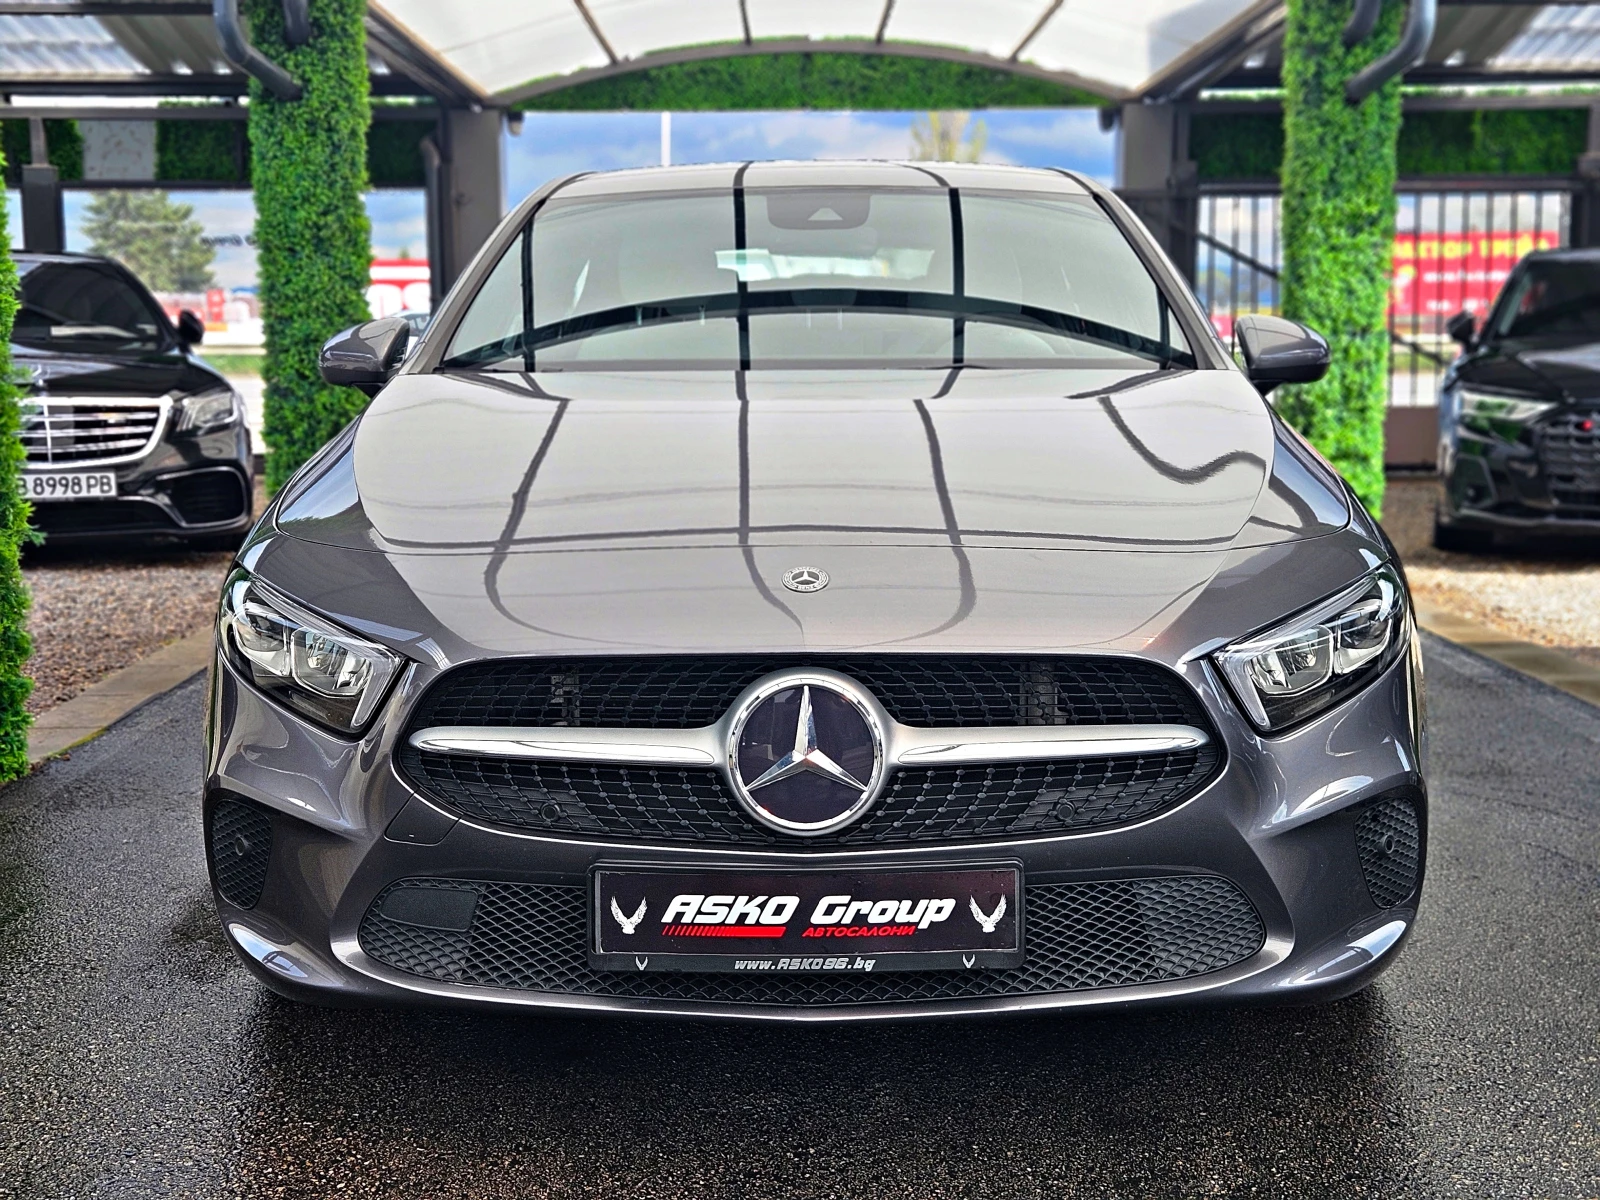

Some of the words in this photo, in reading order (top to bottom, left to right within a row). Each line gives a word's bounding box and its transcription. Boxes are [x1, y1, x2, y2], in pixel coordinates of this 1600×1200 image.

[33, 476, 83, 496] 8998
[86, 475, 113, 494] PB
[660, 894, 800, 925] ASKO
[809, 894, 957, 930] Group
[802, 925, 916, 938] АВТОСАЛОНИ
[734, 956, 877, 972] www.ASKO96.bg
